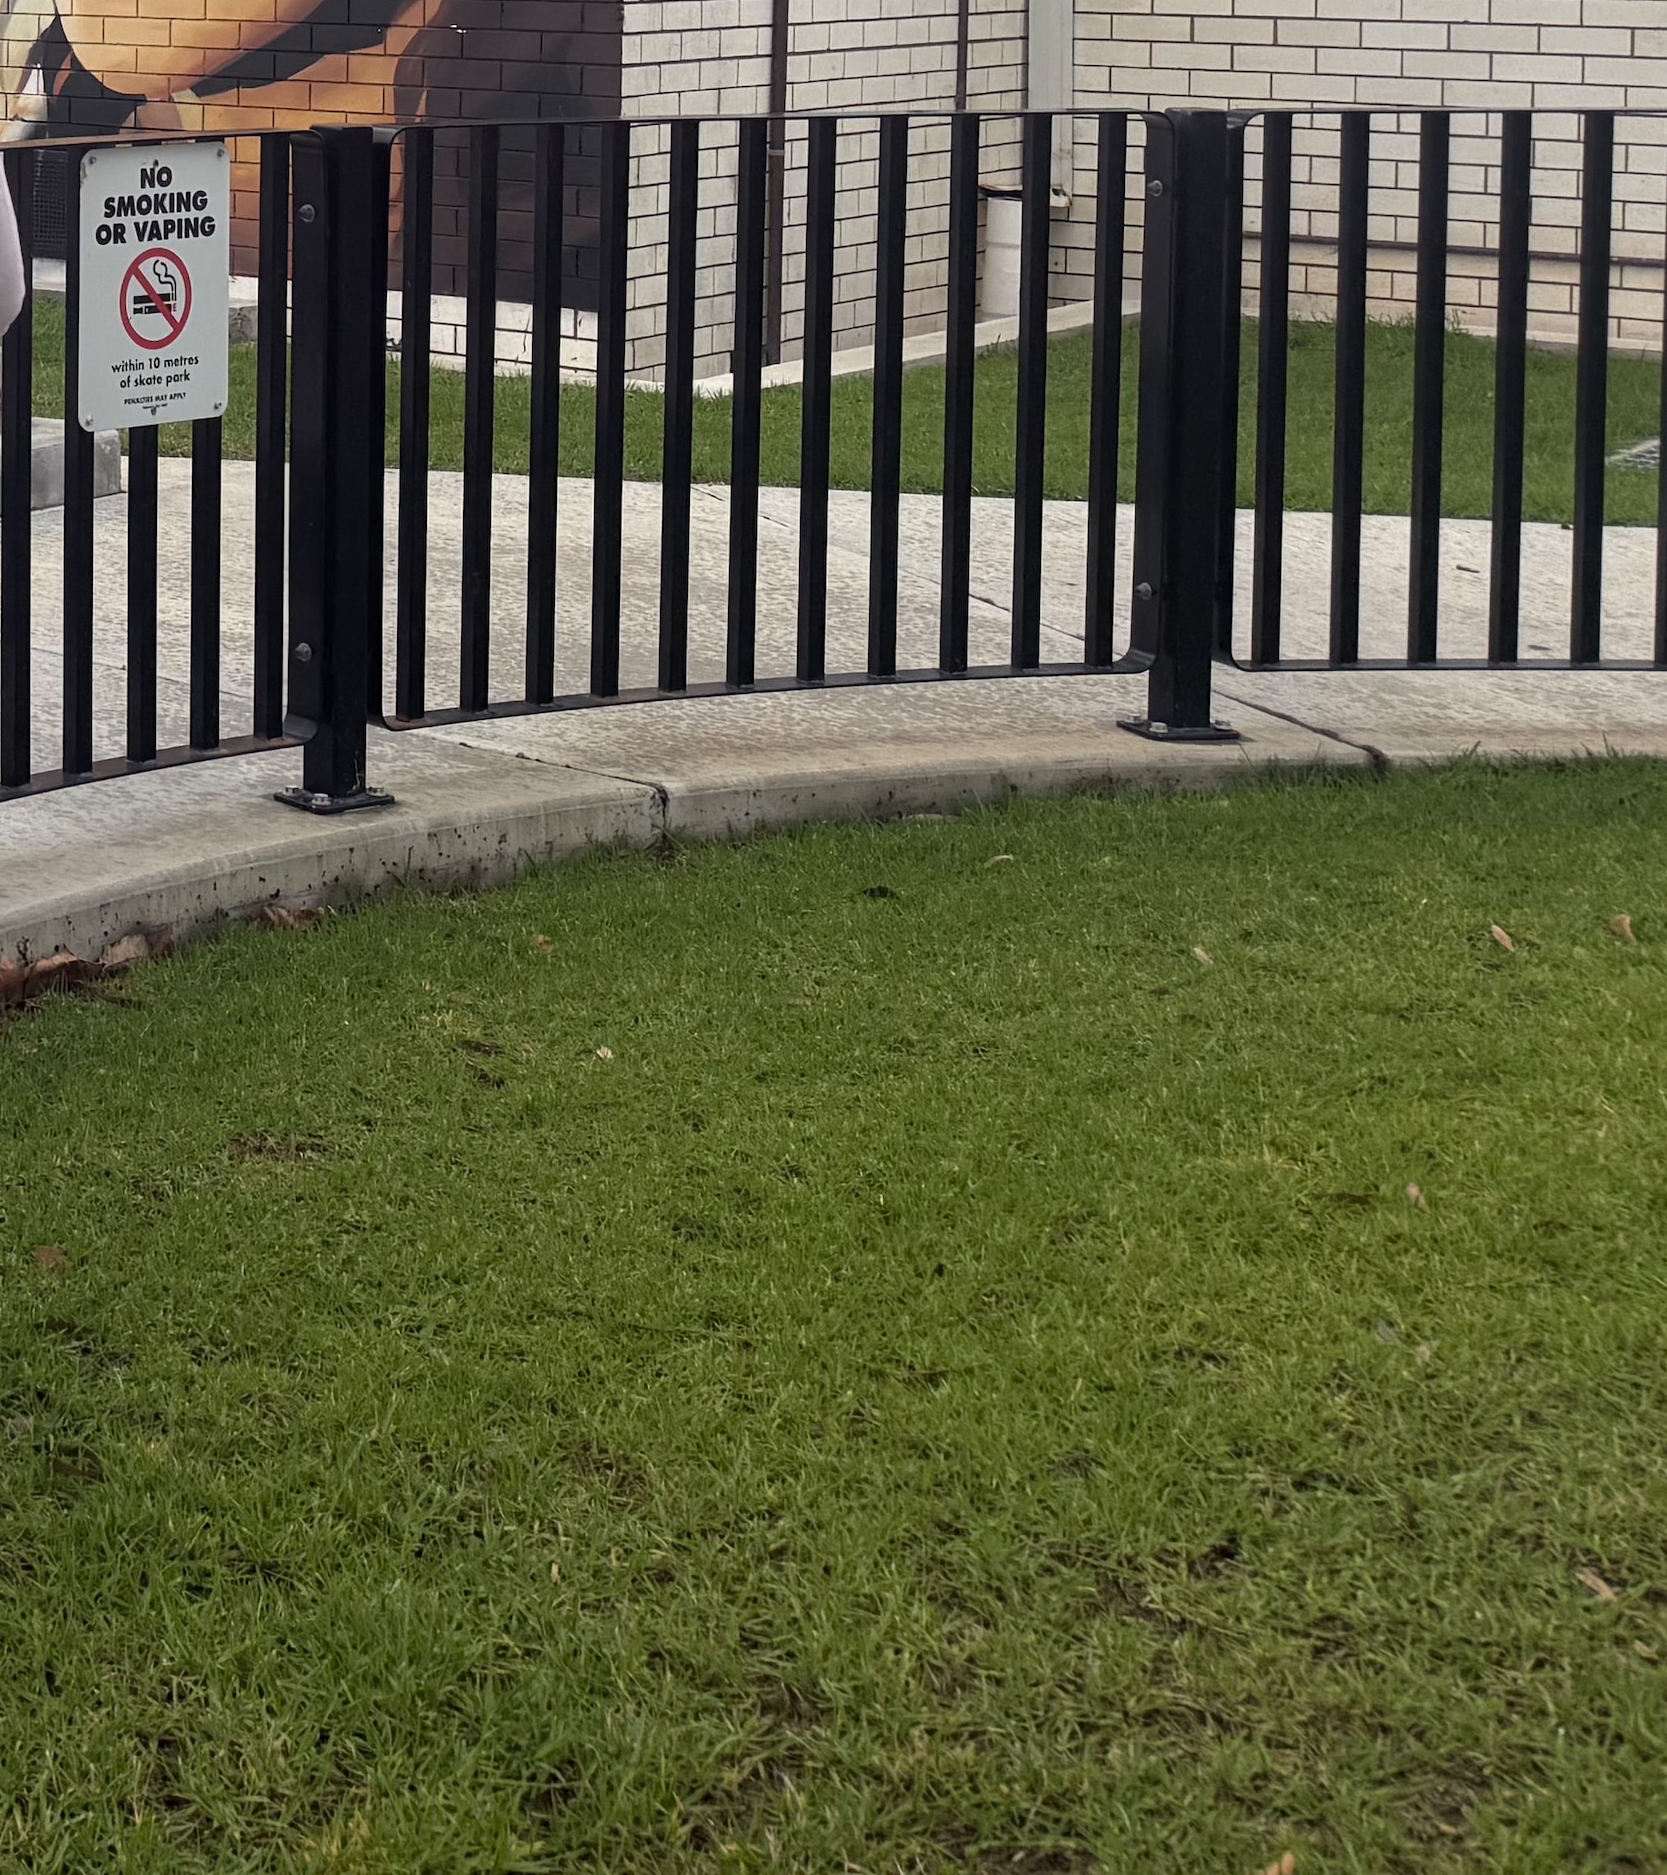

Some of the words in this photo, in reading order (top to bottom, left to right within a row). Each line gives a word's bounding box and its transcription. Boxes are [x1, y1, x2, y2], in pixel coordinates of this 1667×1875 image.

[140, 166, 173, 189] NO
[104, 190, 208, 218] SMOKING
[95, 223, 127, 245] OR
[134, 216, 216, 242] VAPING
[111, 358, 145, 373] within
[148, 357, 160, 369] 10
[164, 355, 199, 368] metres
[120, 375, 131, 388] of
[134, 373, 162, 387] skate
[166, 369, 190, 387] park
